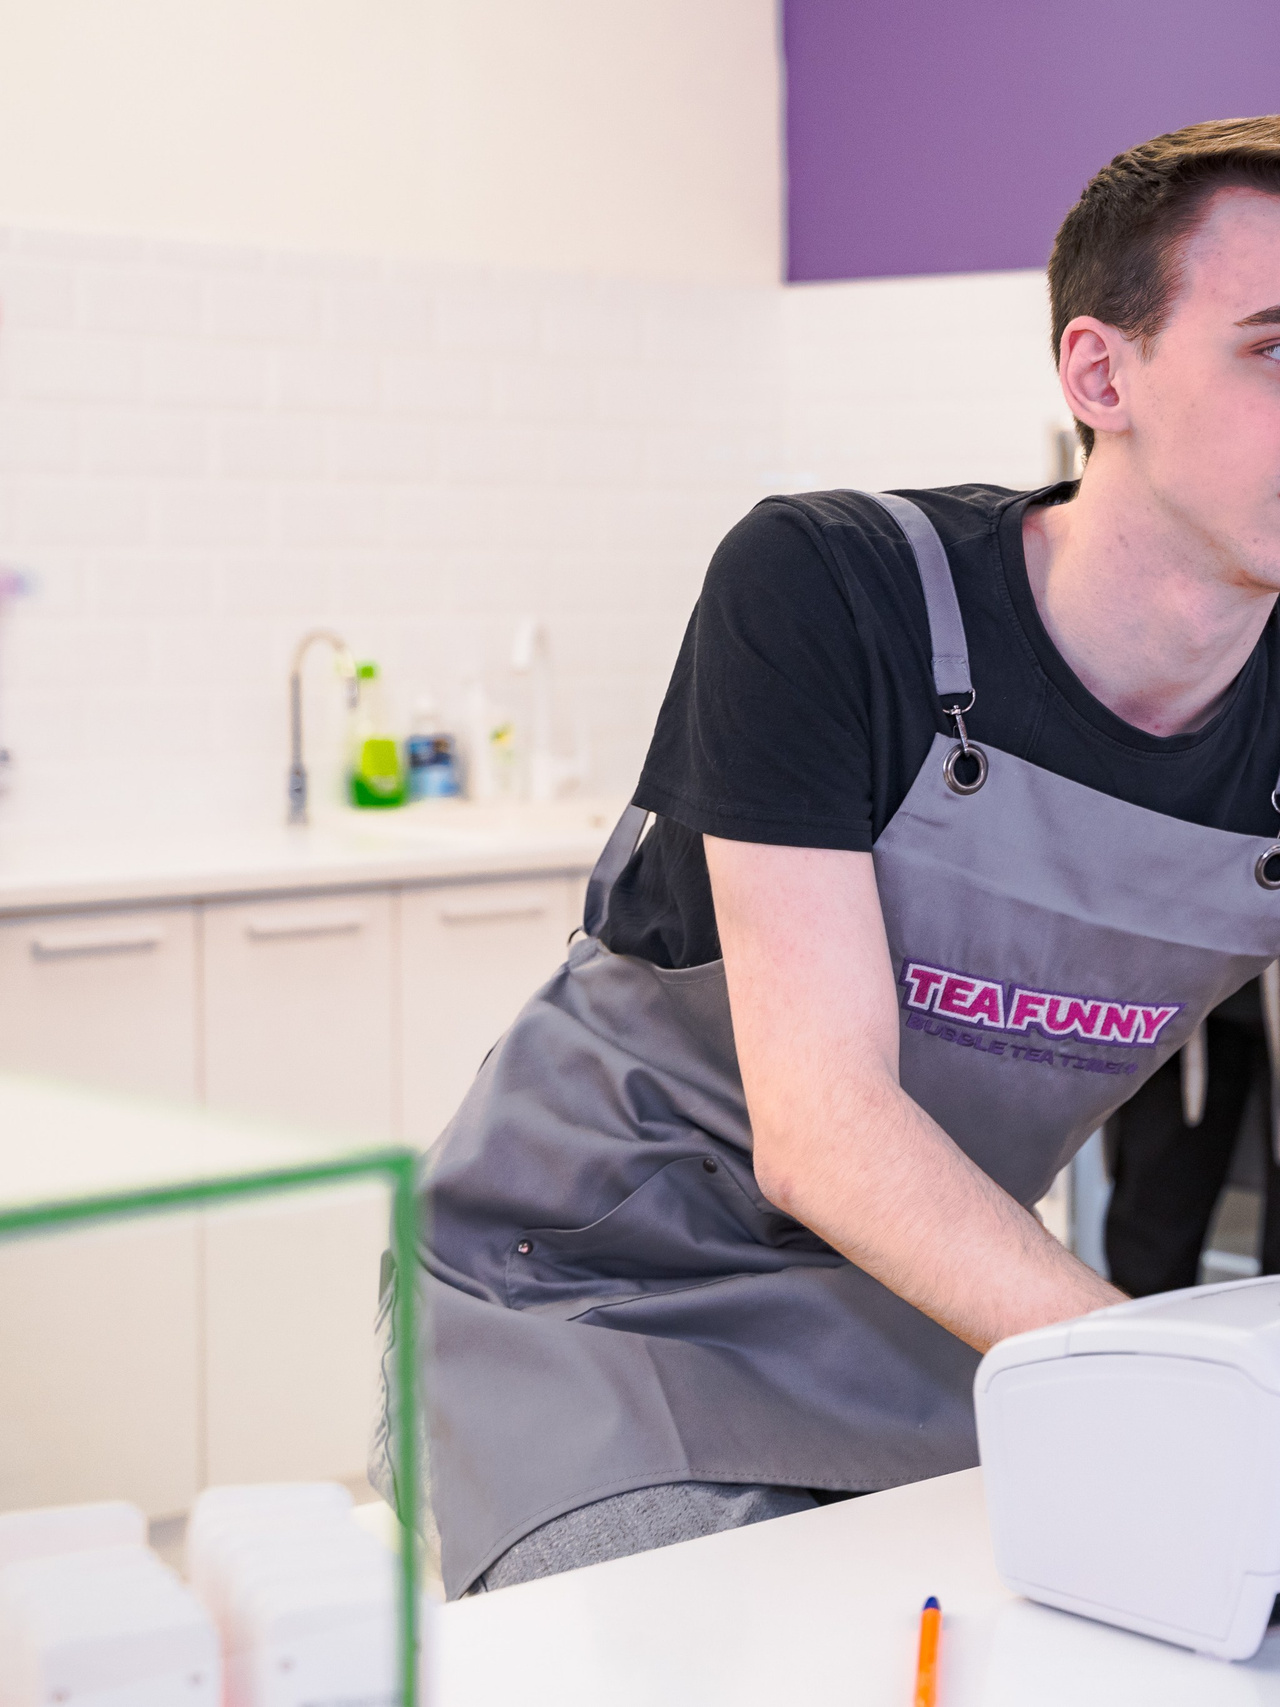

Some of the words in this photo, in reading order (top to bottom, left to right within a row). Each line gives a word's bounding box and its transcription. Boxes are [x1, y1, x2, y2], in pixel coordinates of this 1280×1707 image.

[904, 961, 1006, 1030] TEA
[1005, 987, 1181, 1045] FUNNY
[906, 1013, 1004, 1055] BUBBLE
[1010, 1044, 1054, 1066] TEA
